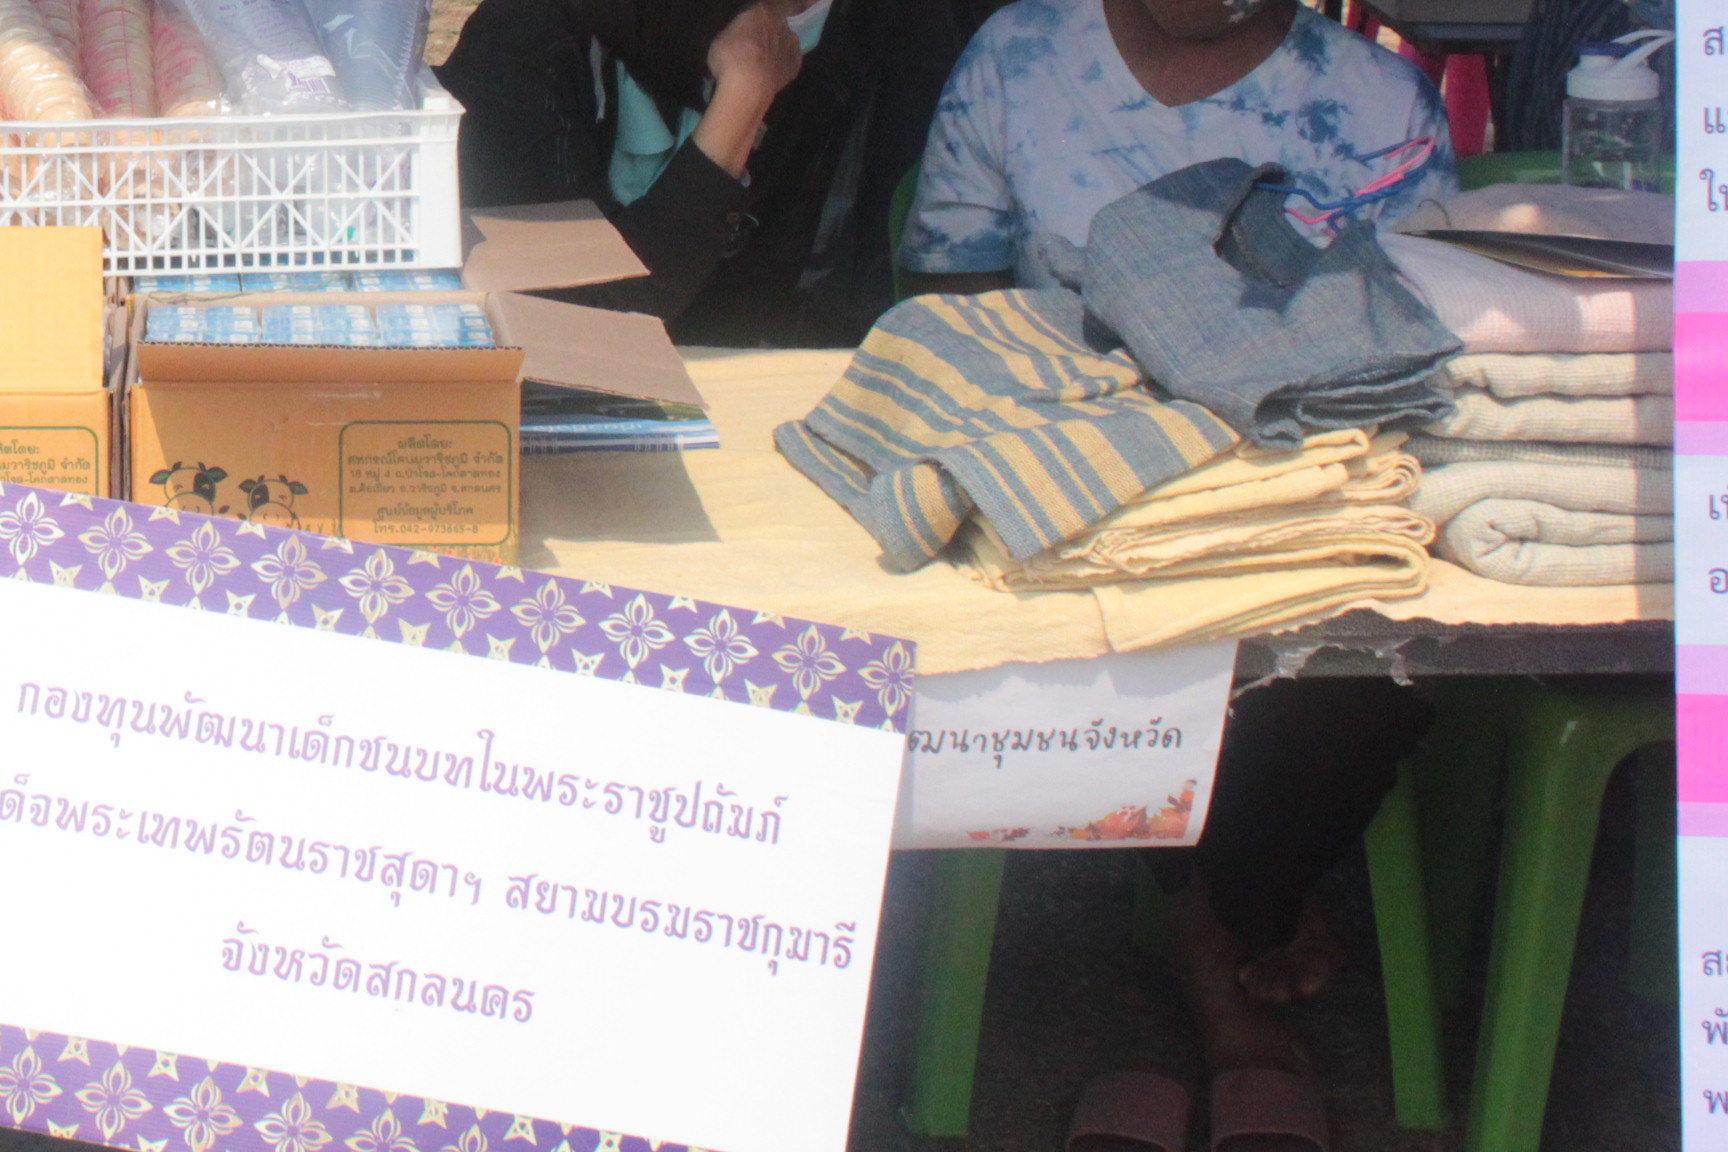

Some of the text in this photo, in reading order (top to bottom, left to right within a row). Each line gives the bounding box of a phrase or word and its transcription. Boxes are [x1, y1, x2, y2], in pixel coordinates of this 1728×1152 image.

[220, 919, 536, 1023] จังหวัดสกลนคร
[505, 870, 857, 978] สยามบรมราชกุมารี
